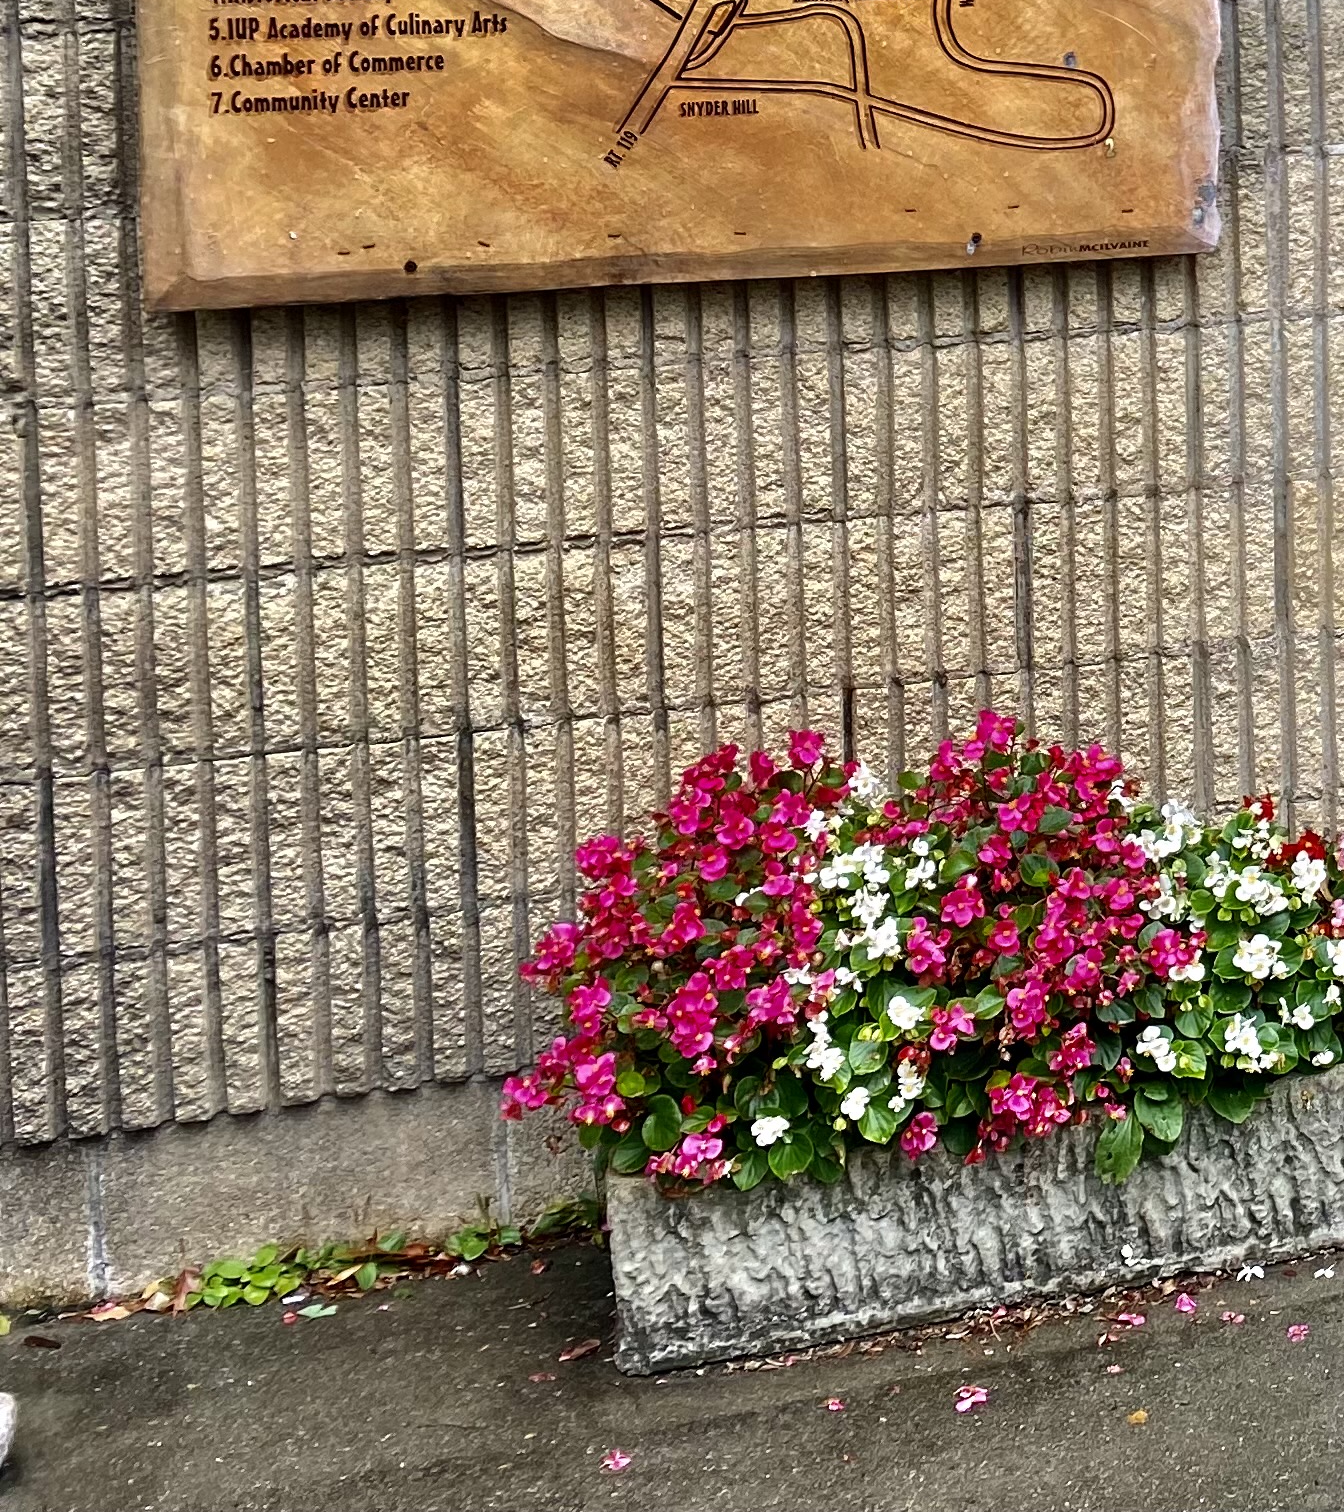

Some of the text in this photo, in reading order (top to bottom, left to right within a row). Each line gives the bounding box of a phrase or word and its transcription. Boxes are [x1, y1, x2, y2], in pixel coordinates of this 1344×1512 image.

[266, 13, 508, 43] Academy of Culinary Arts
[321, 51, 445, 74] of Commerce
[346, 89, 411, 111] Center
[679, 99, 759, 118] SNYDER HILL
[622, 129, 639, 152] 119
[1103, 136, 1117, 159] 2
[1079, 239, 1150, 253] MCILVAINE
